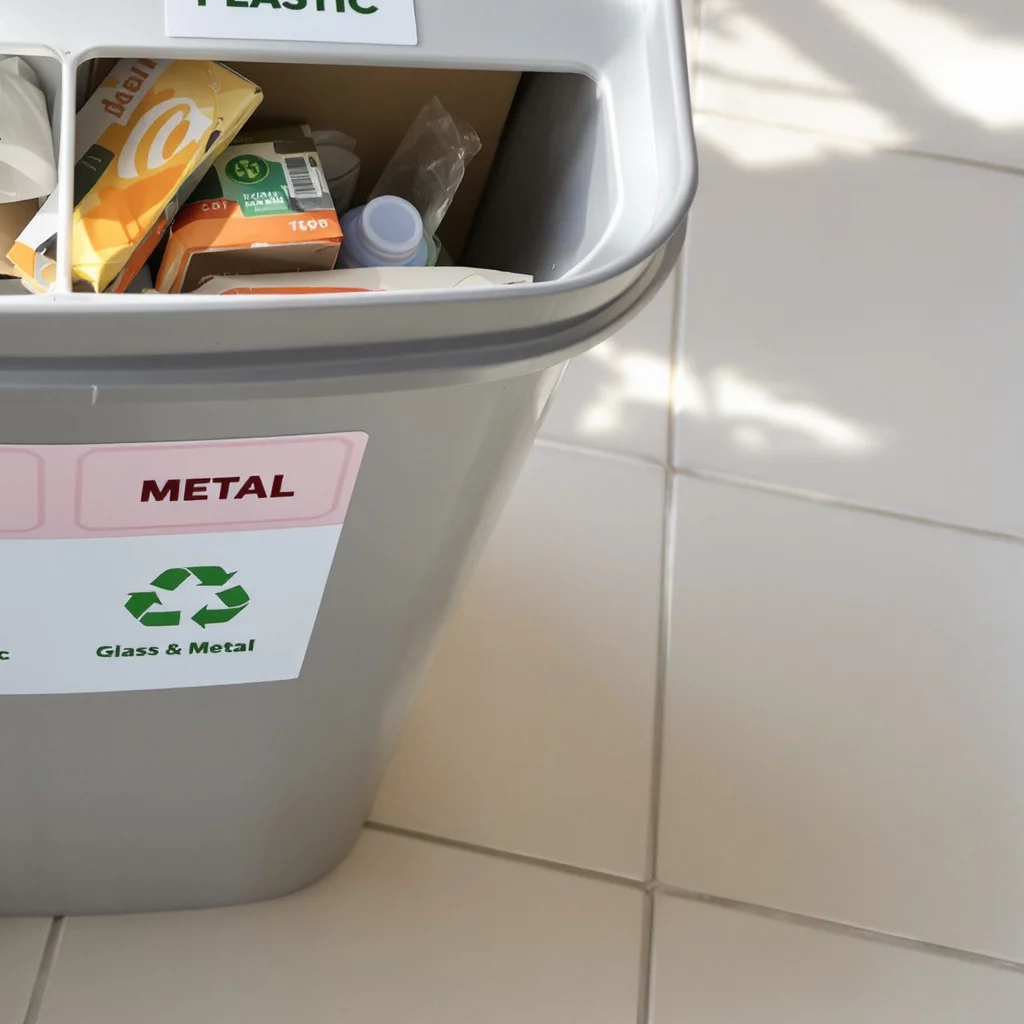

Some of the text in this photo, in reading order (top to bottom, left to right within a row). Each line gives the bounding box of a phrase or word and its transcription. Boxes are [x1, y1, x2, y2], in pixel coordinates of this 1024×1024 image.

[140, 474, 295, 503] METAL
[95, 638, 256, 658] Glass & Metal
